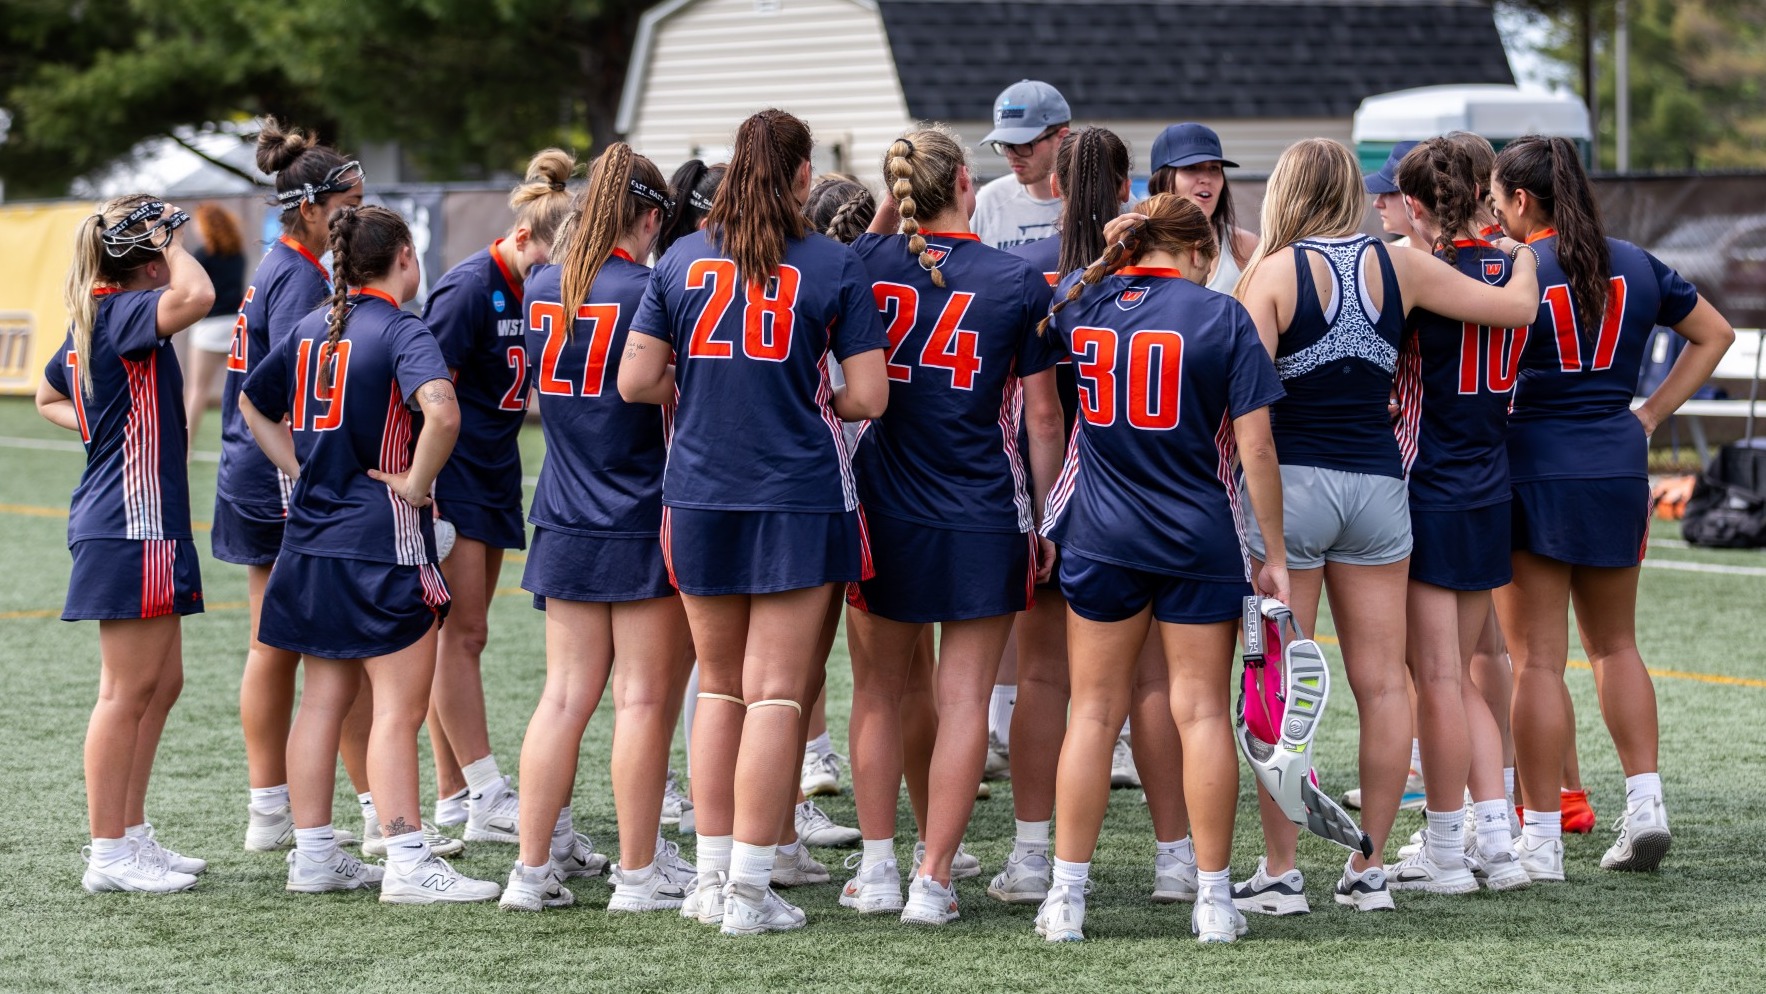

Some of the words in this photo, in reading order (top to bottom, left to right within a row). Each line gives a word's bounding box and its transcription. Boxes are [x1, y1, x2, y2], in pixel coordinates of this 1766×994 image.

[130, 205, 150, 221] GAIT
[648, 188, 664, 202] GAIT
[685, 258, 801, 362] 28
[1120, 290, 1145, 302] W
[1485, 263, 1502, 276] W
[529, 300, 620, 397] 27
[871, 281, 982, 391] 24
[1458, 321, 1529, 395] 10
[1541, 275, 1627, 372] 17
[293, 338, 352, 432] 19
[498, 345, 533, 412] 2
[1071, 326, 1184, 430] 30
